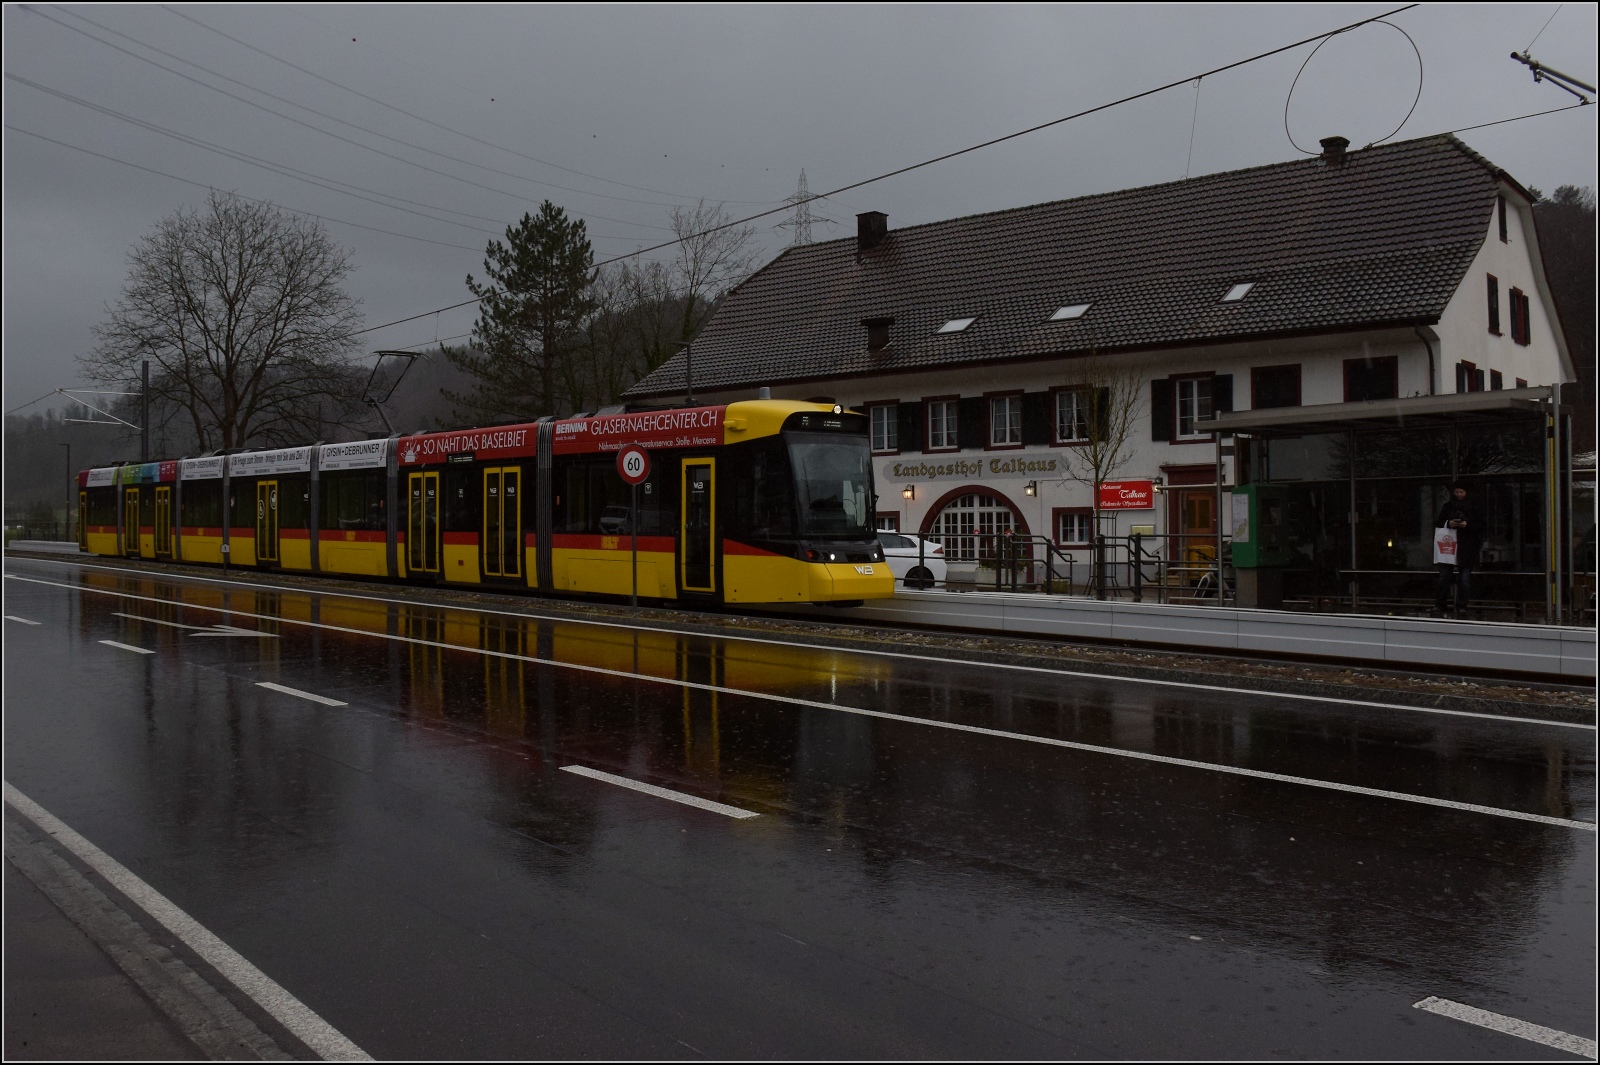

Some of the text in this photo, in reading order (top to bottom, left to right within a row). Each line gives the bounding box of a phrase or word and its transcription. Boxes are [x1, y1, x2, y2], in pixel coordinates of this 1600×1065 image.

[555, 421, 588, 434] BERNINA
[590, 410, 718, 436] GLASER-NAEHCENTER.CH
[423, 430, 527, 455] SO NÄHT DAS BASELBIET
[627, 457, 640, 471] 60
[893, 458, 1057, 479] Landgasthof Talhaus
[1119, 489, 1147, 499] Talhaus
